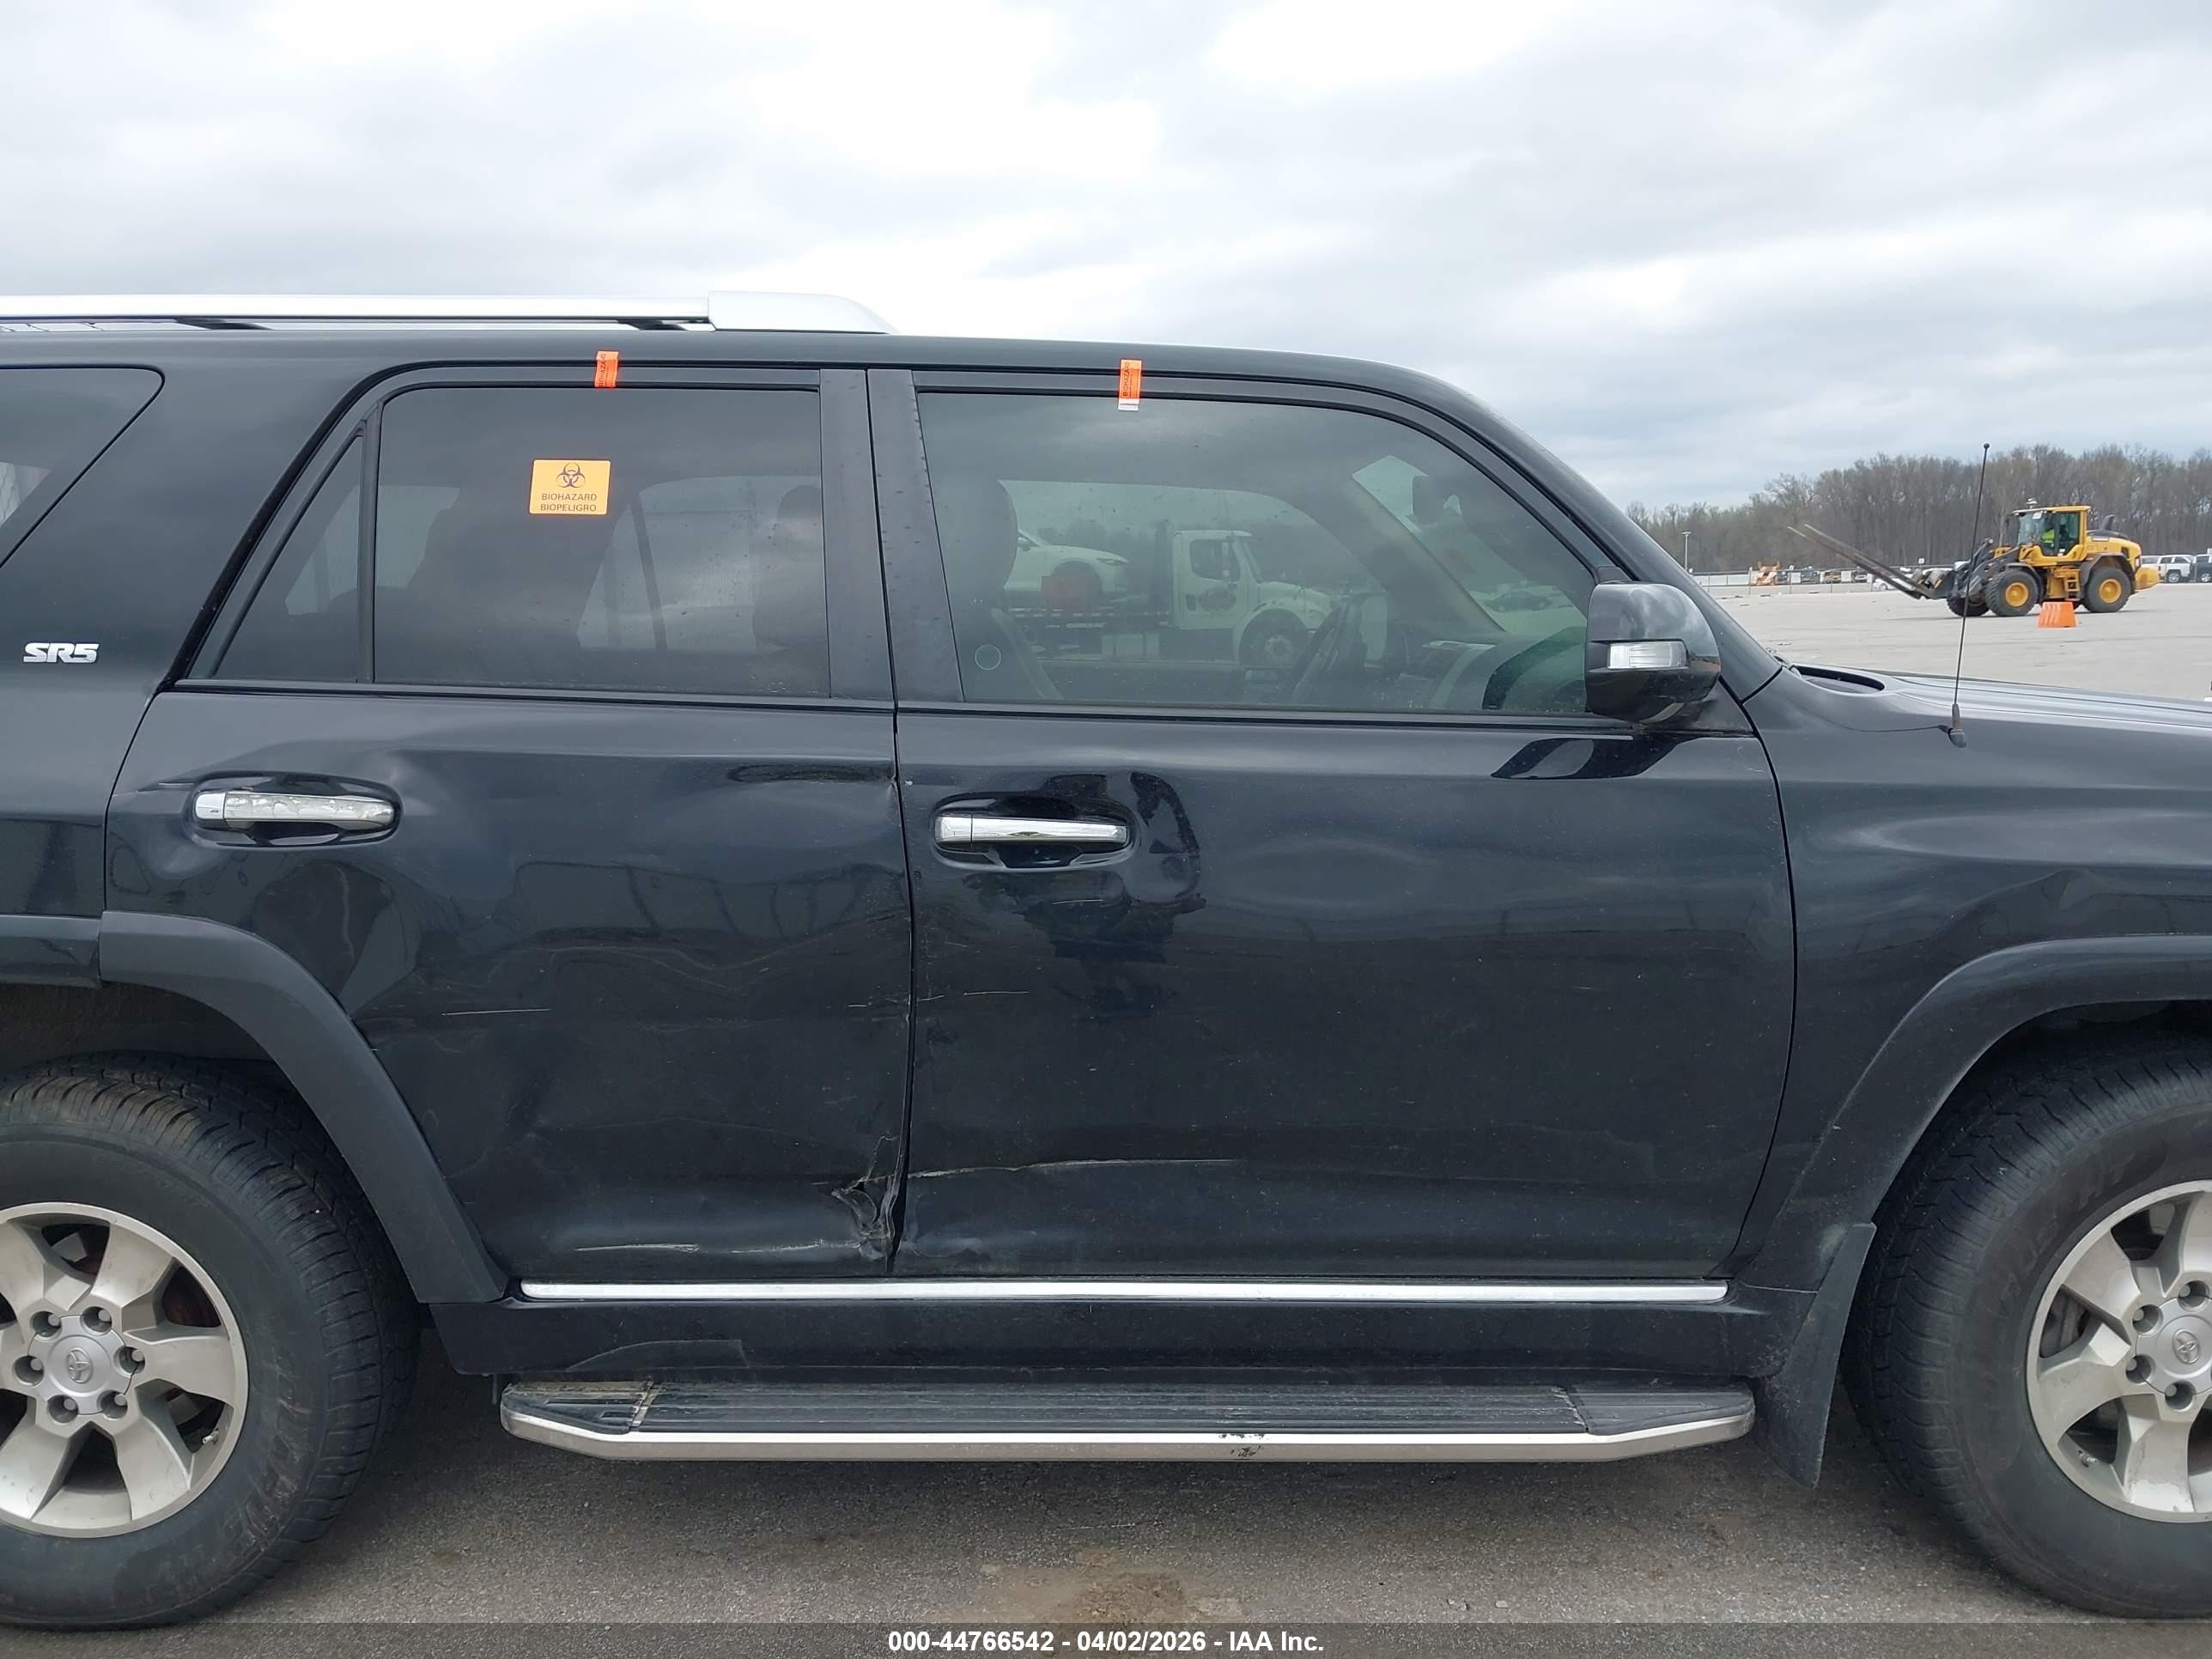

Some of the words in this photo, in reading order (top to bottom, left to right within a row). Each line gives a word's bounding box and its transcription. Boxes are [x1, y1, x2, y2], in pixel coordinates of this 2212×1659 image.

[541, 493, 598, 501] BIOHAZARD
[540, 503, 597, 512] BIOPELIGRO
[23, 642, 100, 664] SR5
